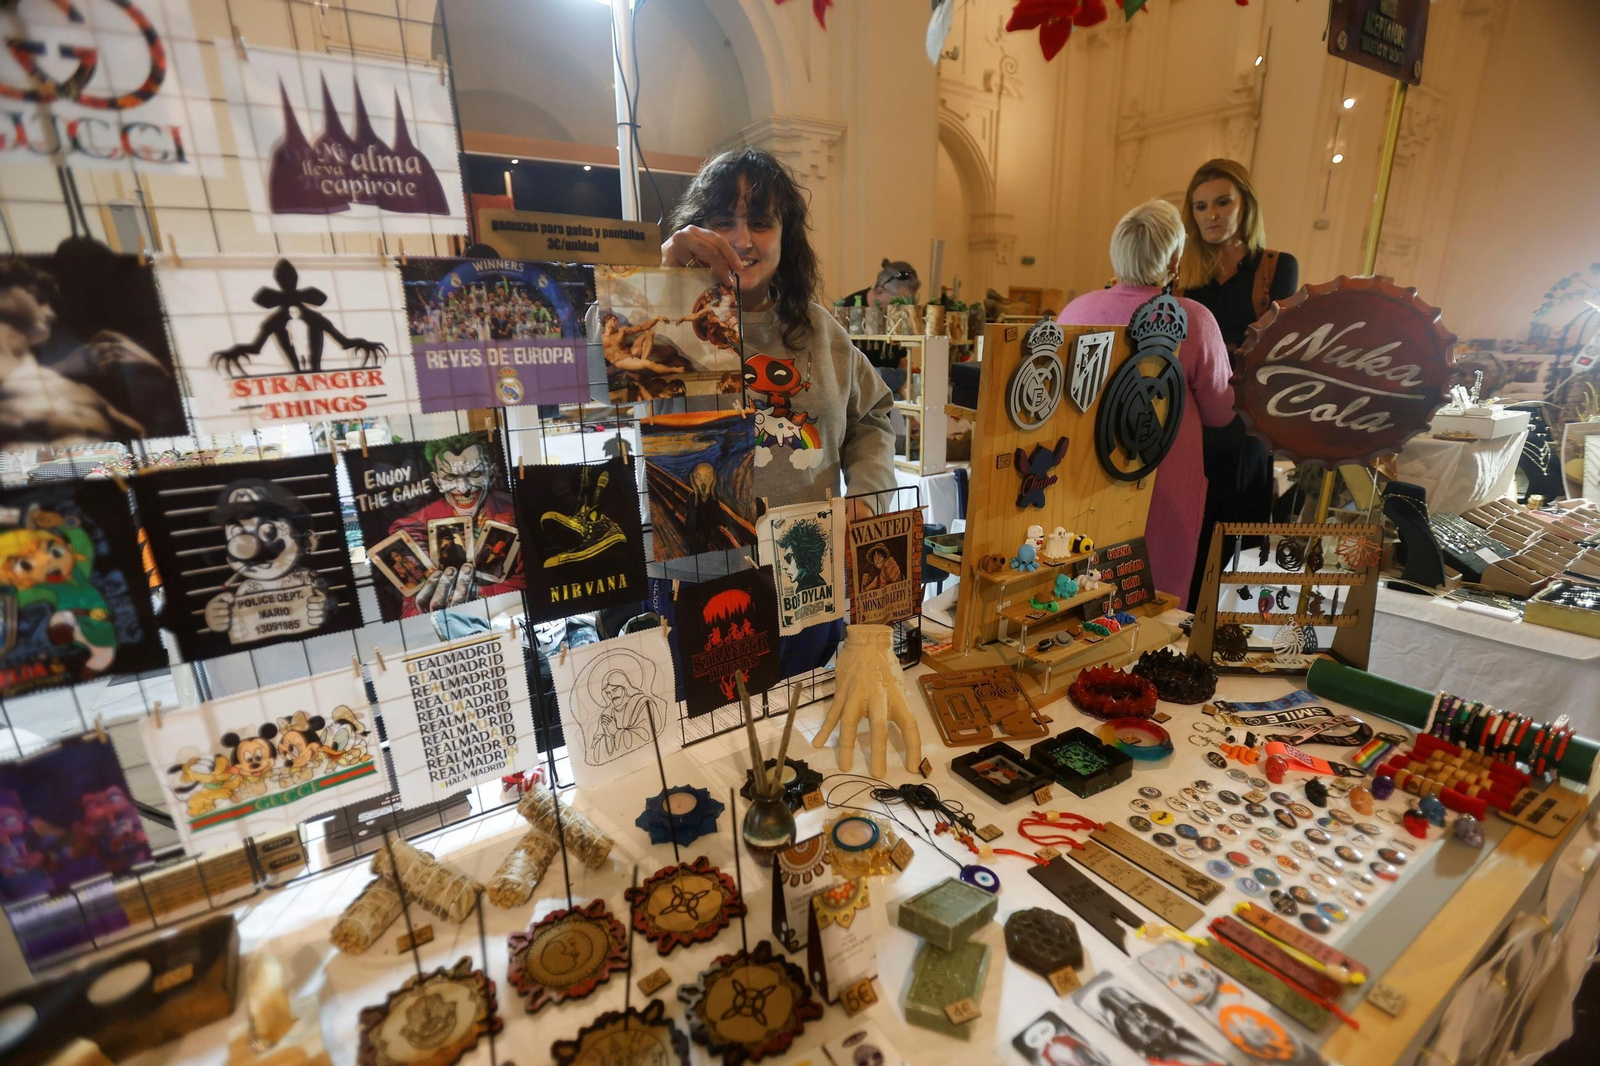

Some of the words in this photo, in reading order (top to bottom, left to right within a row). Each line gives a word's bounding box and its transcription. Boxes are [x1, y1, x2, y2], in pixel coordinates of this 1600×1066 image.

[0, 108, 189, 164] UCCI
[302, 160, 344, 175] lleva
[315, 142, 345, 163] Mi
[351, 145, 422, 174] alma
[321, 174, 417, 202] capirote
[541, 223, 564, 235] para
[566, 224, 593, 237] gafas
[595, 227, 600, 238] y
[602, 229, 646, 241] pantallas
[547, 238, 599, 252] 3€/unidad
[472, 260, 525, 272] WINNERS
[425, 348, 482, 369] REYES
[487, 348, 510, 366] DE
[514, 347, 575, 364] EUROPA
[1265, 321, 1424, 387] Nuka
[233, 370, 386, 398] STRANGER
[264, 395, 368, 419] THINGS
[1266, 380, 1395, 433] Cola
[364, 465, 412, 489] ENJOY
[355, 491, 389, 512] THE
[392, 478, 432, 502] GAME
[851, 517, 911, 545] WANTED
[238, 593, 275, 609] POLICE
[277, 590, 304, 602] DEPT.
[550, 573, 628, 603] NIRVANA
[802, 585, 833, 604] DYLAN
[258, 607, 290, 619] MARIO
[255, 620, 300, 635] 13091985
[692, 634, 770, 676] STRANGER
[709, 655, 760, 683] THINGS
[1265, 706, 1327, 724] SMILE
[445, 774, 467, 788] HALA
[470, 761, 506, 778] MADRID
[255, 782, 316, 810] GUCCI
[807, 793, 820, 806] 8€
[1036, 788, 1052, 803] 10€
[1040, 847, 1056, 859] 3€
[1055, 972, 1076, 991] 6€
[845, 982, 874, 1012] 5€
[954, 1002, 974, 1017] 4€
